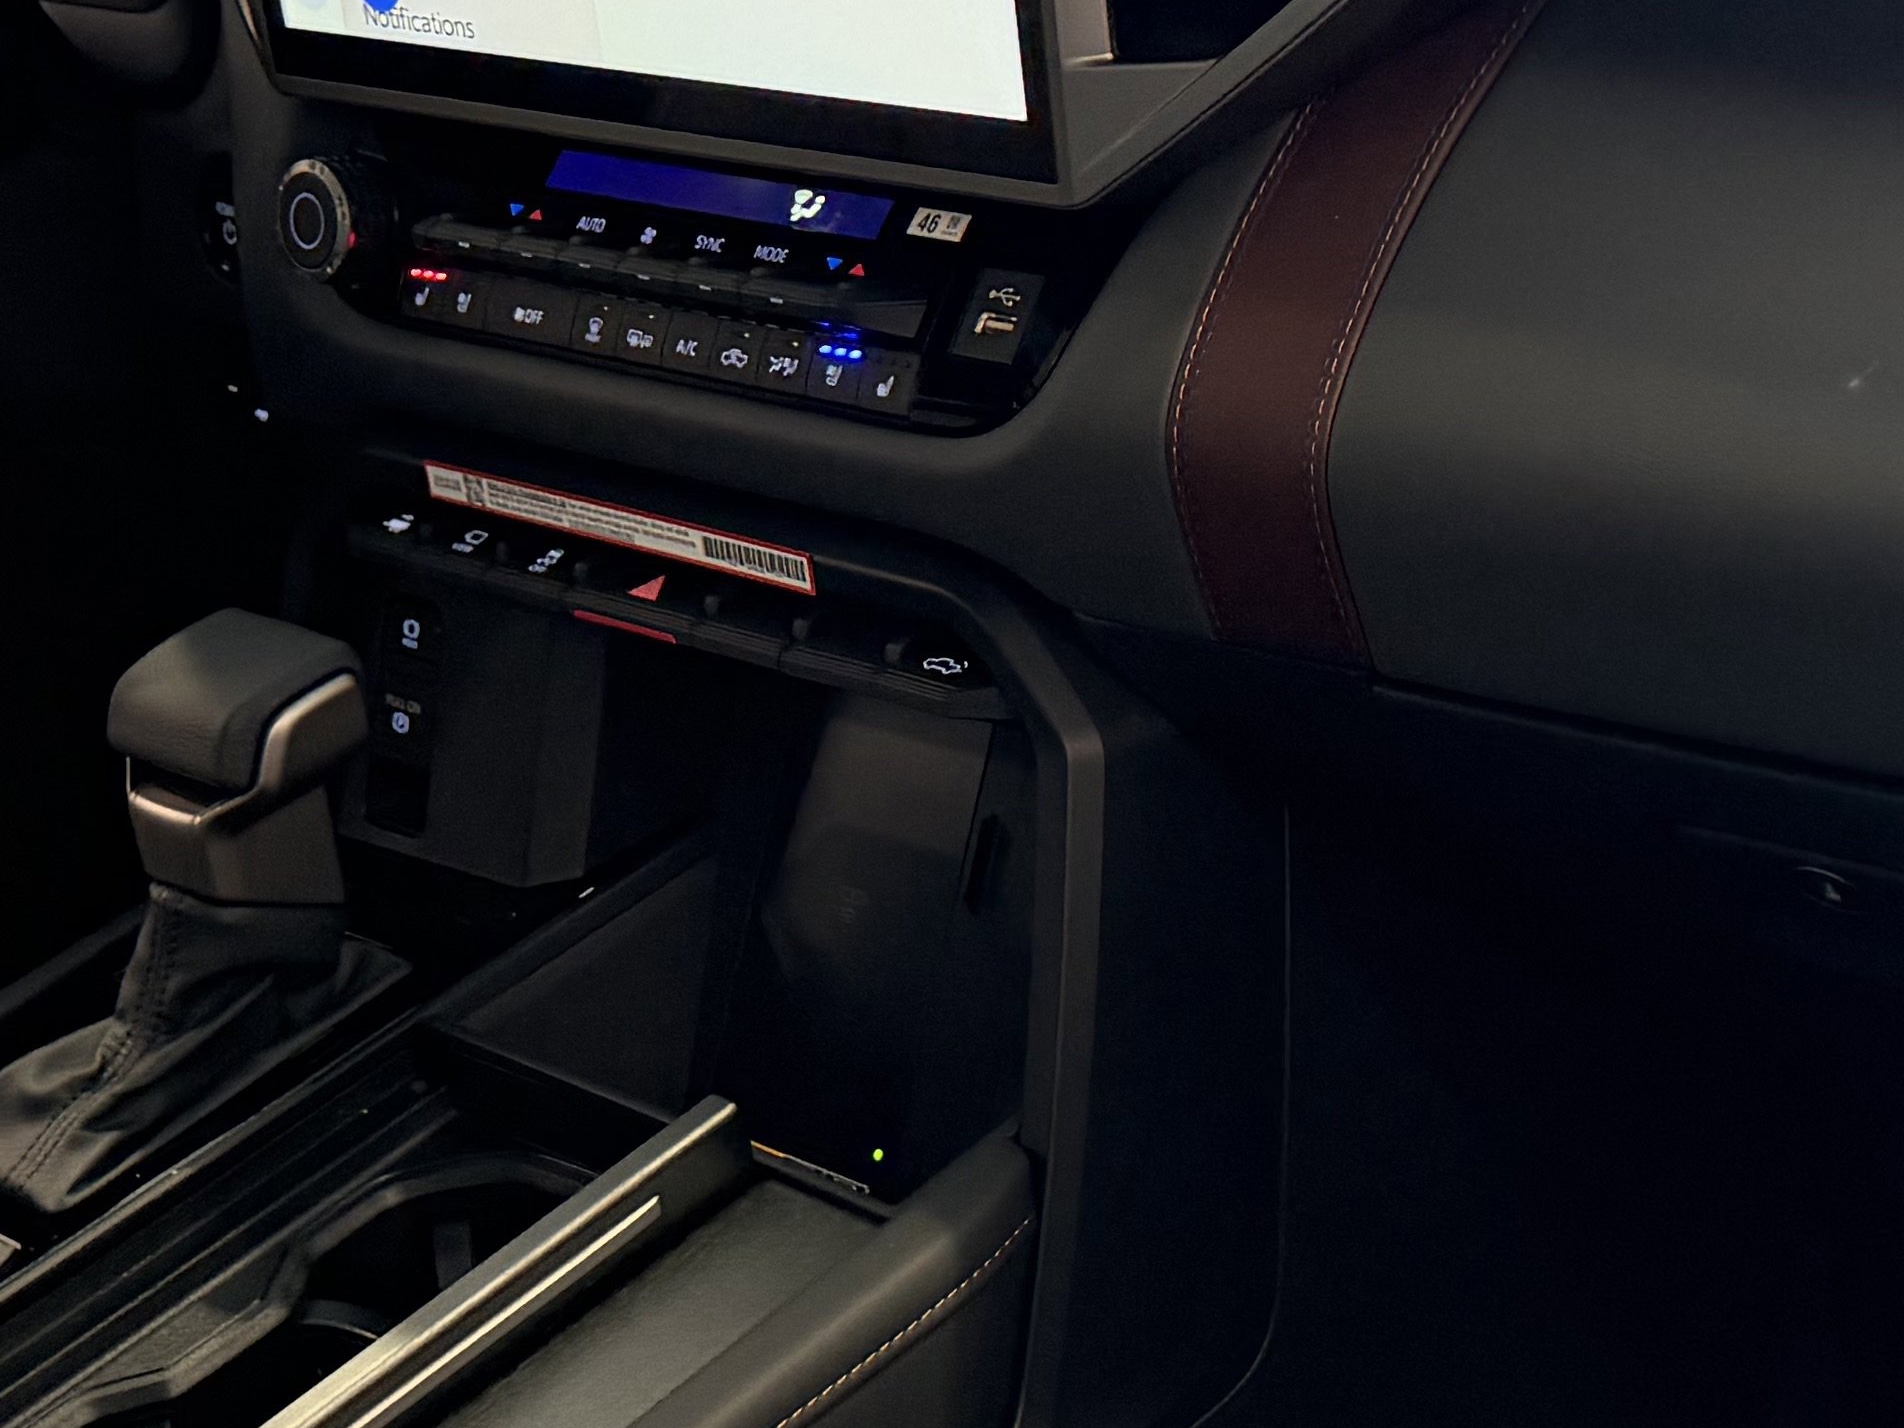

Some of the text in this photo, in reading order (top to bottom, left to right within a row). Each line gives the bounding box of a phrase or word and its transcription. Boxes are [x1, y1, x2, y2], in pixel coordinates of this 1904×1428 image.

[361, 5, 476, 40] Notifications
[575, 215, 607, 234] AUTO
[916, 211, 943, 235] 46
[694, 233, 726, 254] SYNC
[753, 243, 791, 265] MODE
[524, 306, 545, 326] OFF
[675, 338, 699, 358] A/C
